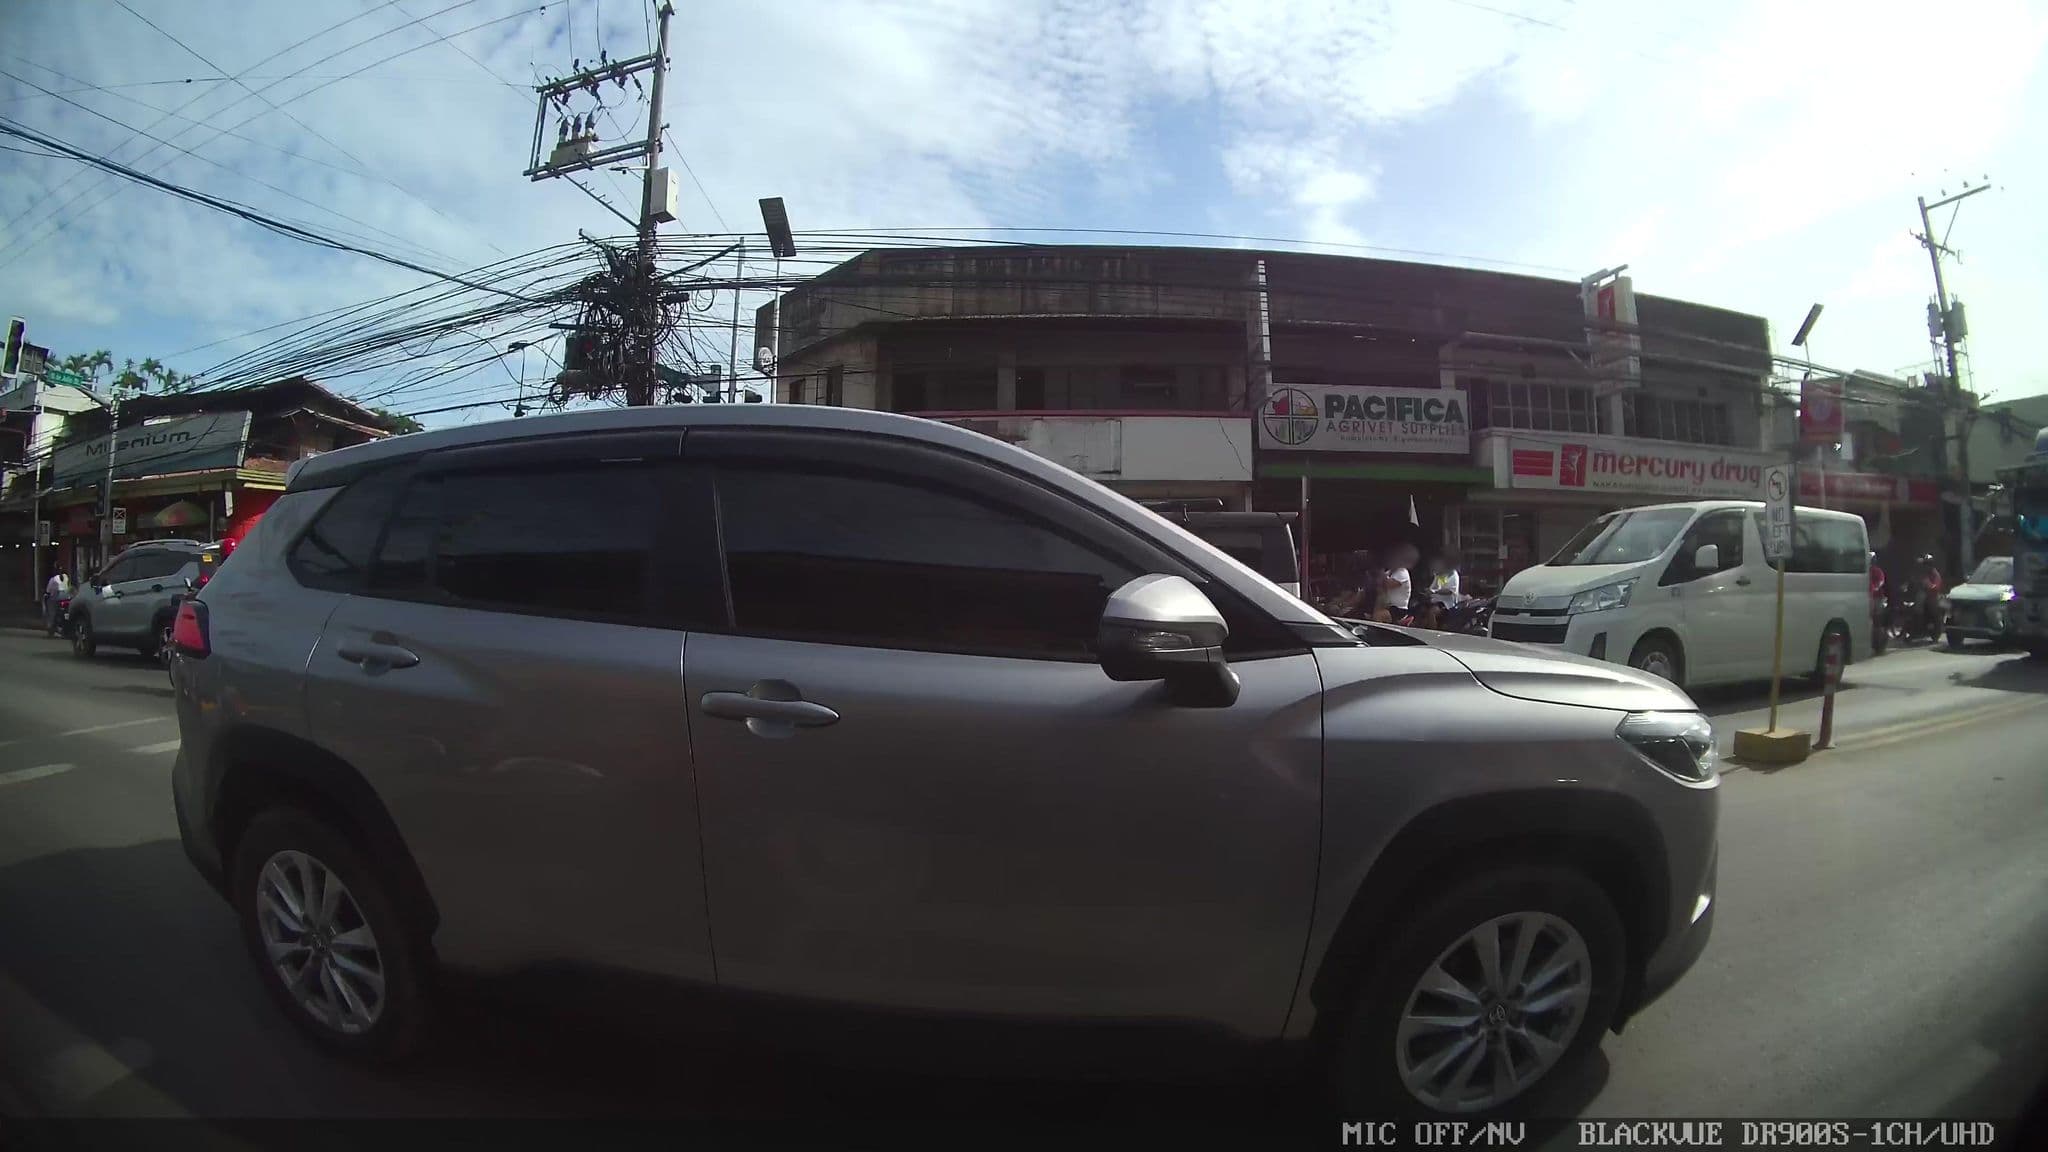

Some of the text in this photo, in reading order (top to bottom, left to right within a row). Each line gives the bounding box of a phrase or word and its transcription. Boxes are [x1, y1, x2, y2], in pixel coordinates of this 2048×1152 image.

[1324, 394, 1464, 423] PACIFICA
[1326, 420, 1393, 434] AGRIVET
[1592, 452, 1761, 488] mercury drug
